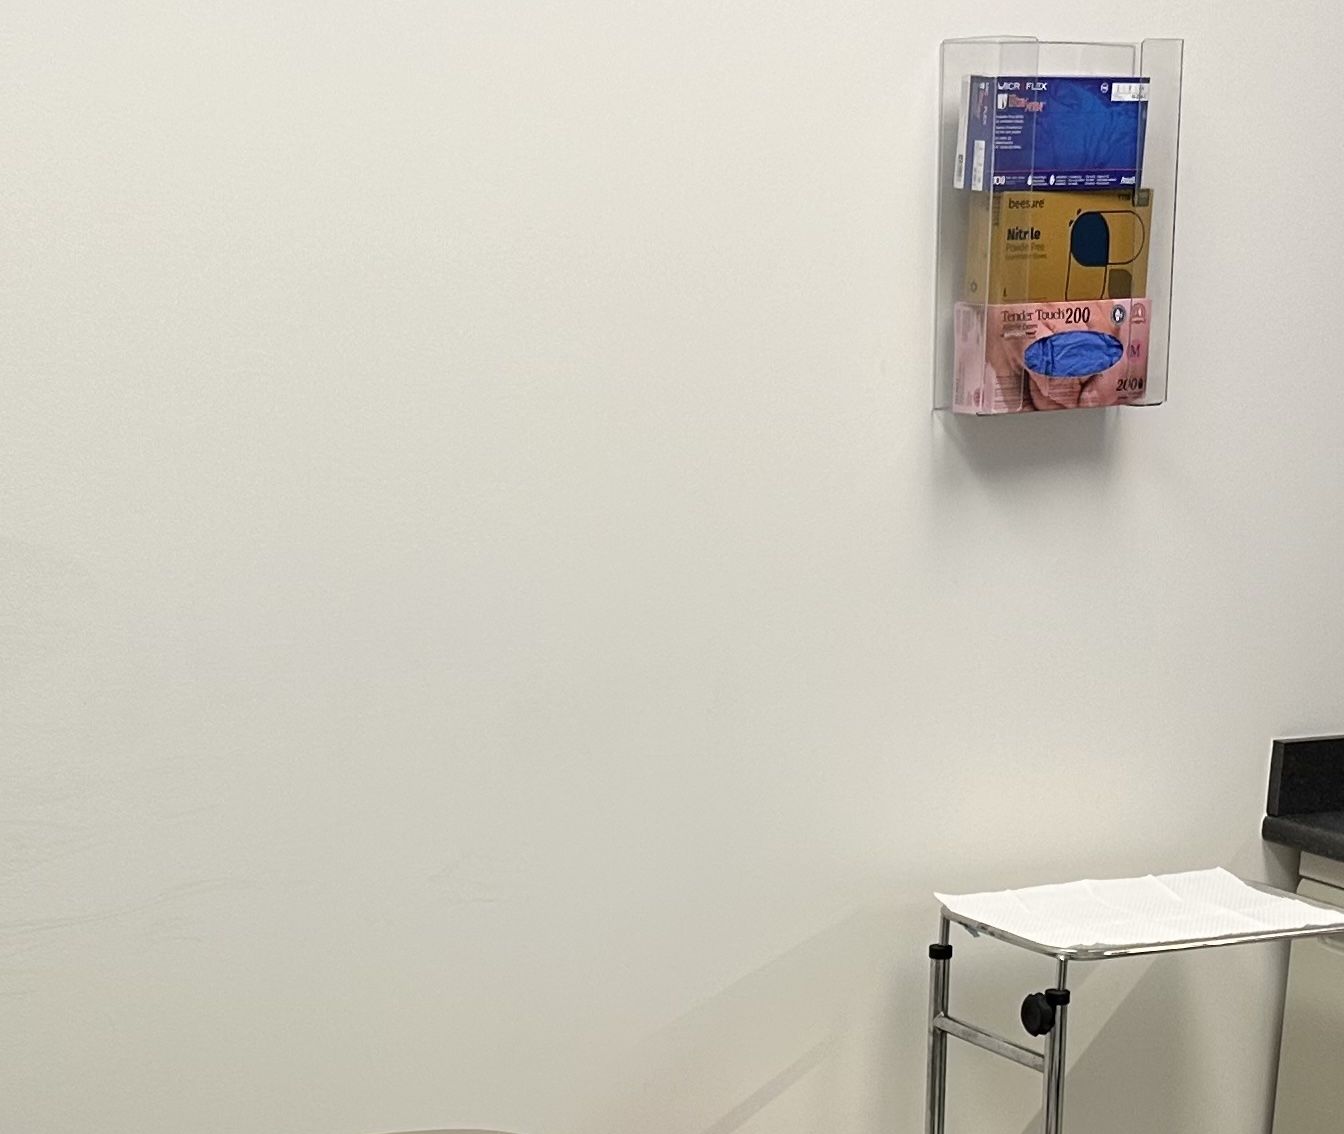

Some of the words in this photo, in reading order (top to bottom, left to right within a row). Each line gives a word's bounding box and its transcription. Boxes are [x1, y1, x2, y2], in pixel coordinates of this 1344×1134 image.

[997, 81, 1048, 91] MICRFLEX
[1000, 310, 1034, 322] Tender
[1035, 308, 1064, 321] Touch
[1065, 307, 1091, 324] 200
[1129, 344, 1141, 358] M
